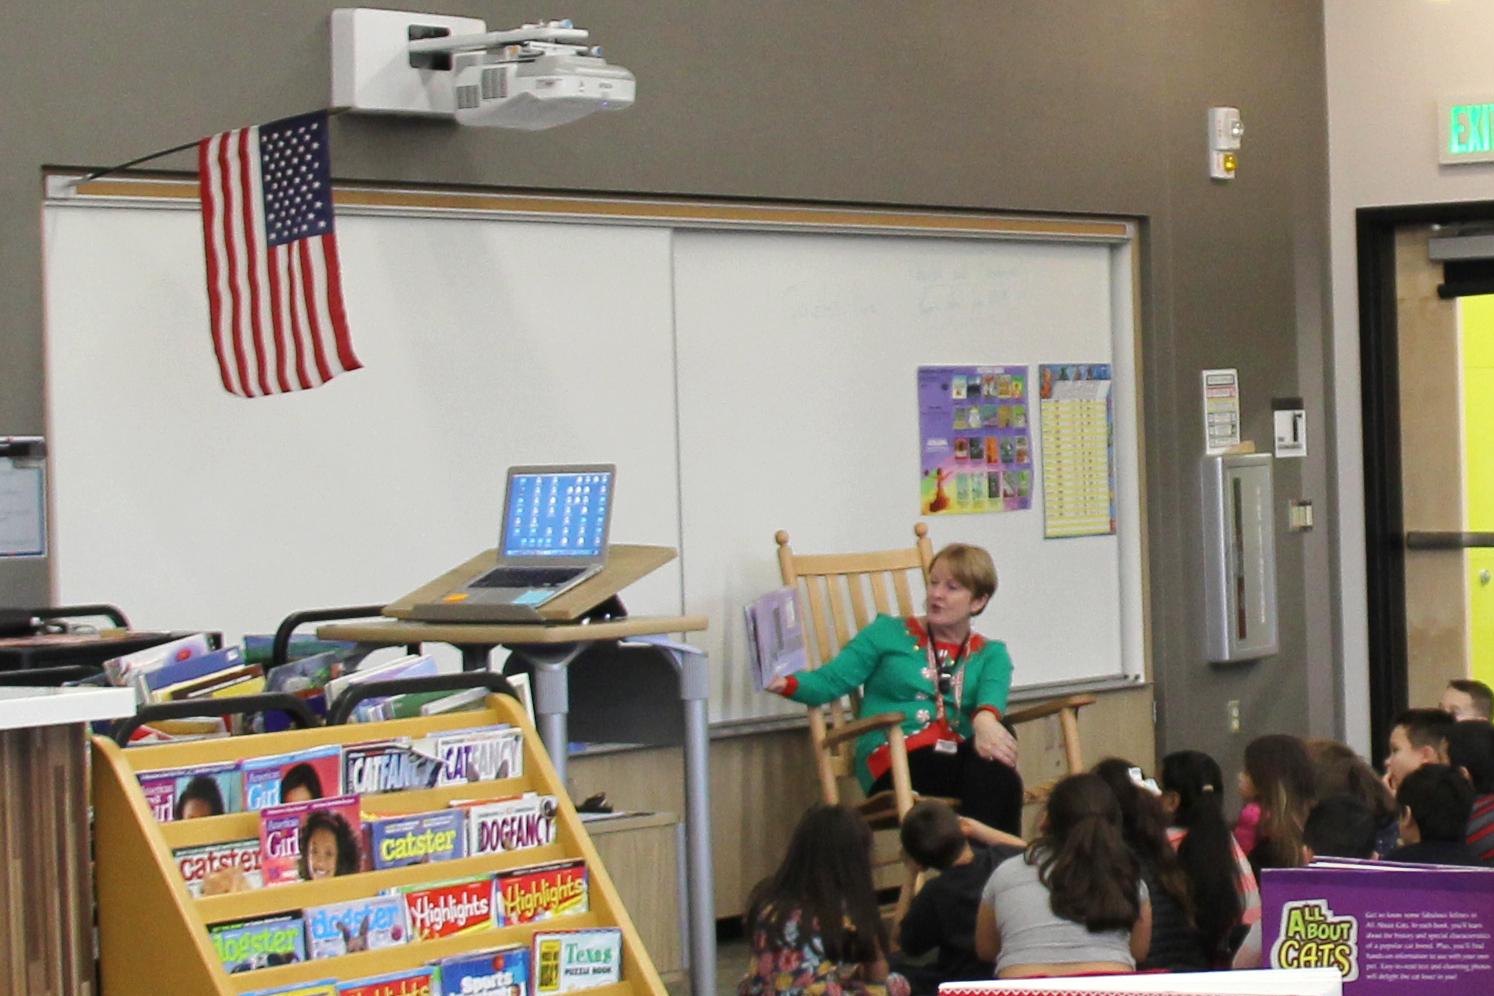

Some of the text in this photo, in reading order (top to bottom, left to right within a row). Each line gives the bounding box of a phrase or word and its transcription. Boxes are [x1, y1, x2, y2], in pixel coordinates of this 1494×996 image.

[267, 828, 300, 858] Girl
[380, 827, 456, 862] catster
[180, 848, 263, 881] catster
[411, 891, 489, 930] Highlights
[505, 874, 585, 918] Highlights
[566, 943, 613, 964] Texas
[1278, 939, 1352, 977] CATS
[461, 971, 515, 993] Sports
